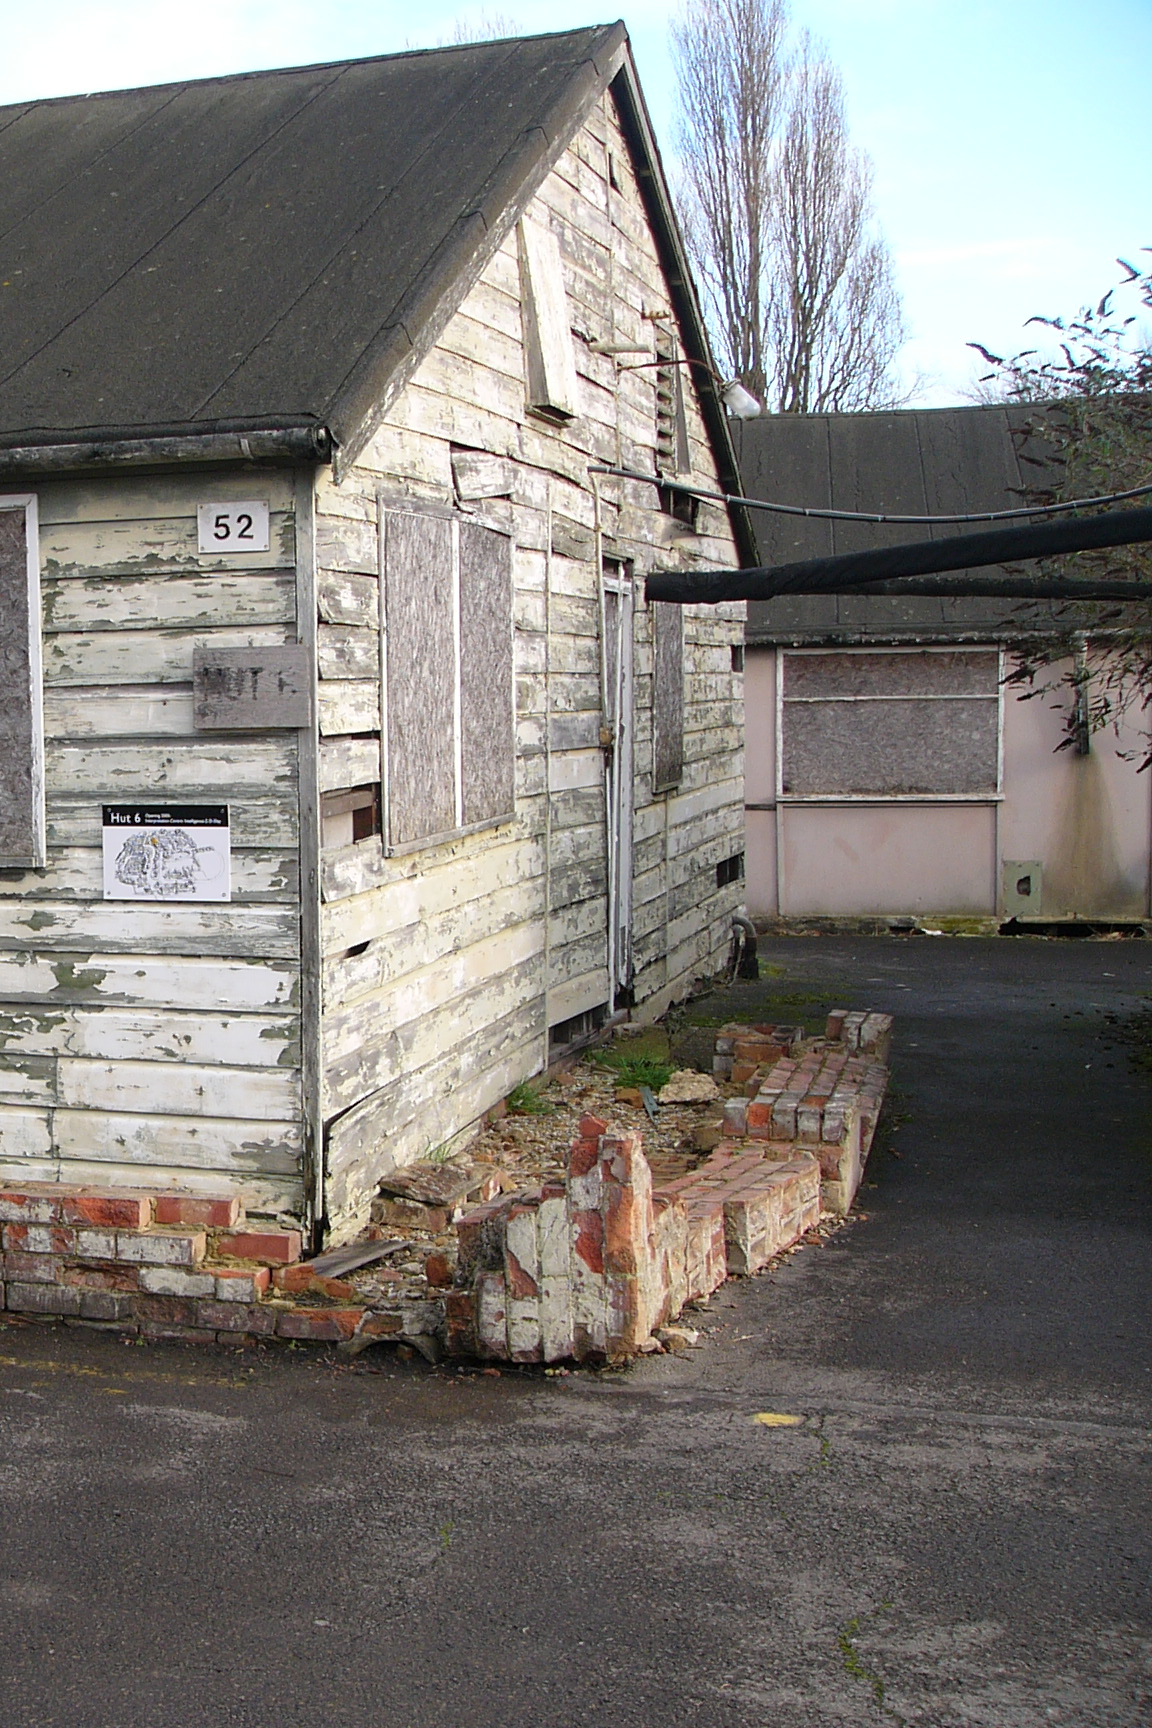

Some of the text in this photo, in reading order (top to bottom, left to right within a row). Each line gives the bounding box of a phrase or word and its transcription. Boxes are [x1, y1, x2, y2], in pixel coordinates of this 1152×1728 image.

[213, 514, 254, 540] 52
[110, 813, 131, 824] Hut
[134, 813, 141, 823] 6
